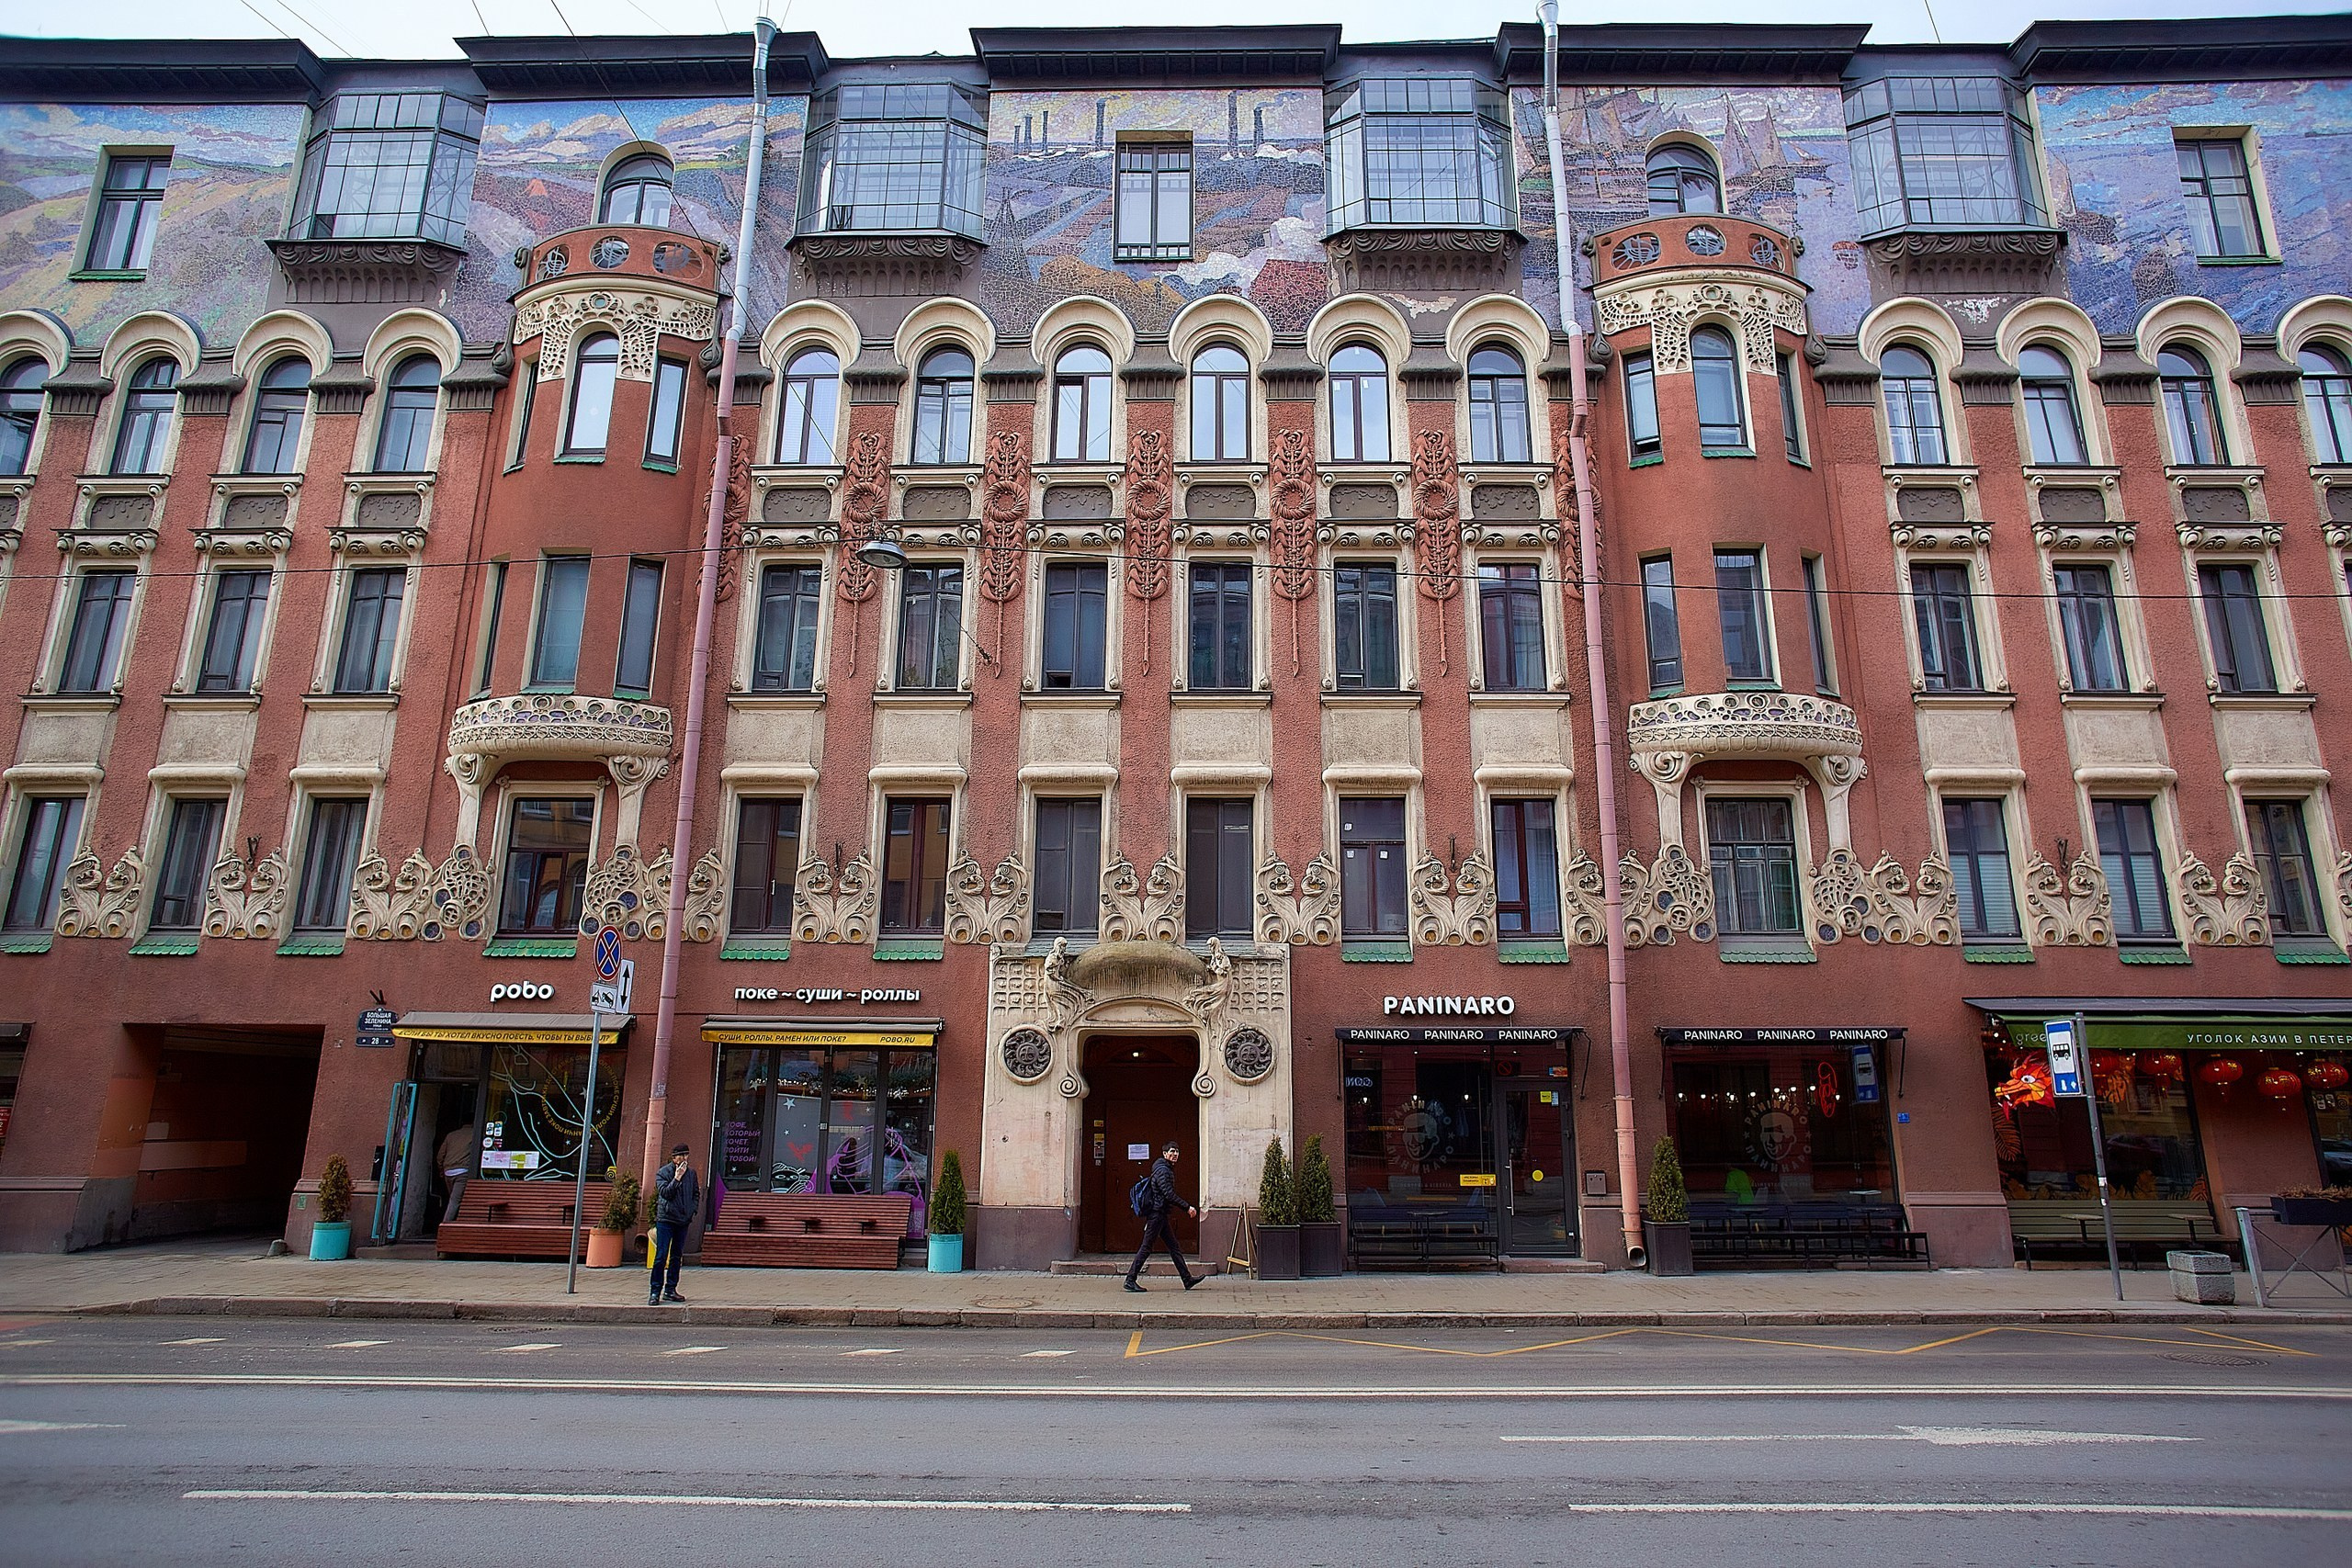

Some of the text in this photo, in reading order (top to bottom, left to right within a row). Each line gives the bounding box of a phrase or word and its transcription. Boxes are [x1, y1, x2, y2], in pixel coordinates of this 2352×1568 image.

[490, 980, 555, 1002] pobo
[735, 987, 778, 999] поке
[796, 988, 842, 1003] суши
[861, 988, 920, 1003] роллы
[1384, 996, 1515, 1015] PANINARO
[1351, 1030, 1558, 1040] PANINARO PANINARO PANINARO
[1684, 1030, 1888, 1040] PANINARO PANINARO PANINARO
[2016, 1033, 2046, 1046] gree
[2188, 1034, 2244, 1044] УГОЛОК
[2251, 1034, 2288, 1044] АЗИИ
[2295, 1034, 2302, 1043] В
